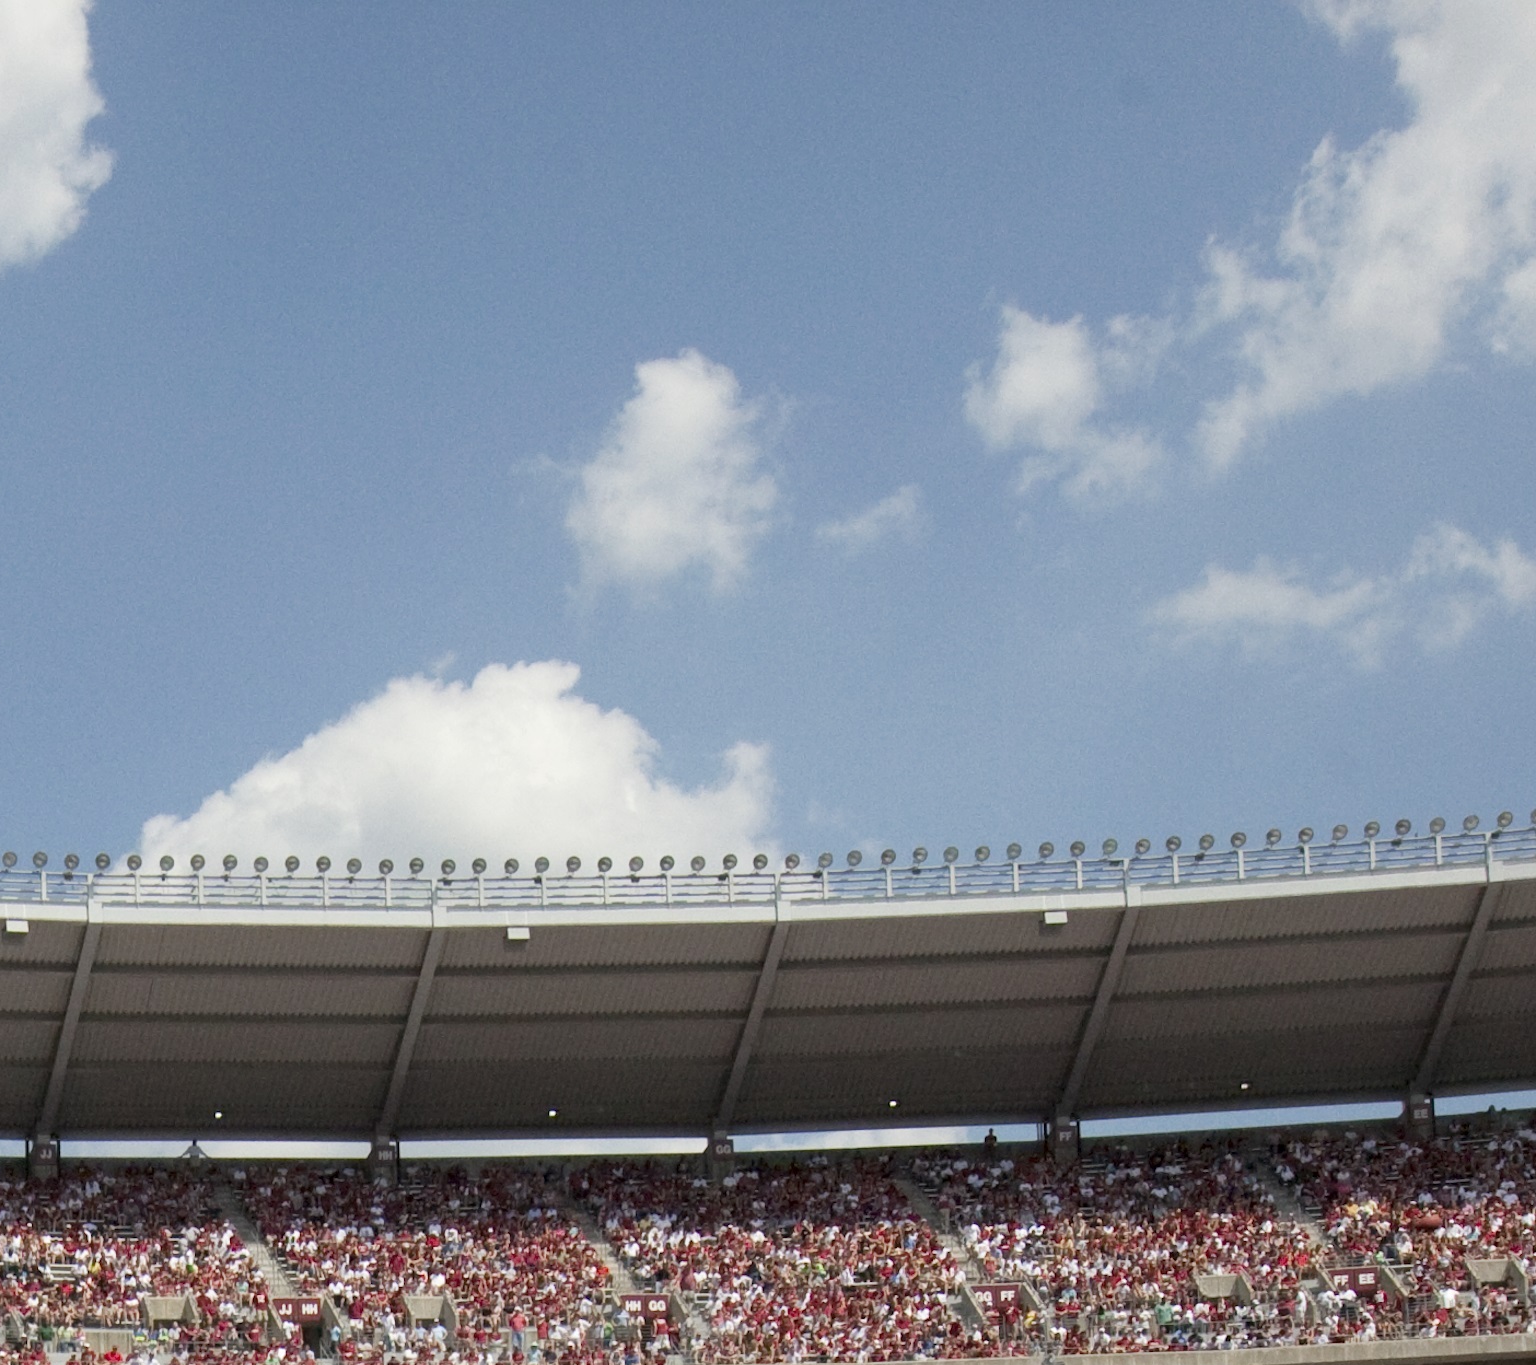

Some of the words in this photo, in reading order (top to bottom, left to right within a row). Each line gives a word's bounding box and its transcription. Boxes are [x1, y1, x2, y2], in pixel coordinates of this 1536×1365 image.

[1358, 1273, 1375, 1285] EE
[1000, 1290, 1015, 1302] FF
[278, 1303, 292, 1315] JJ
[301, 1303, 318, 1315] HH
[625, 1299, 641, 1312] HH
